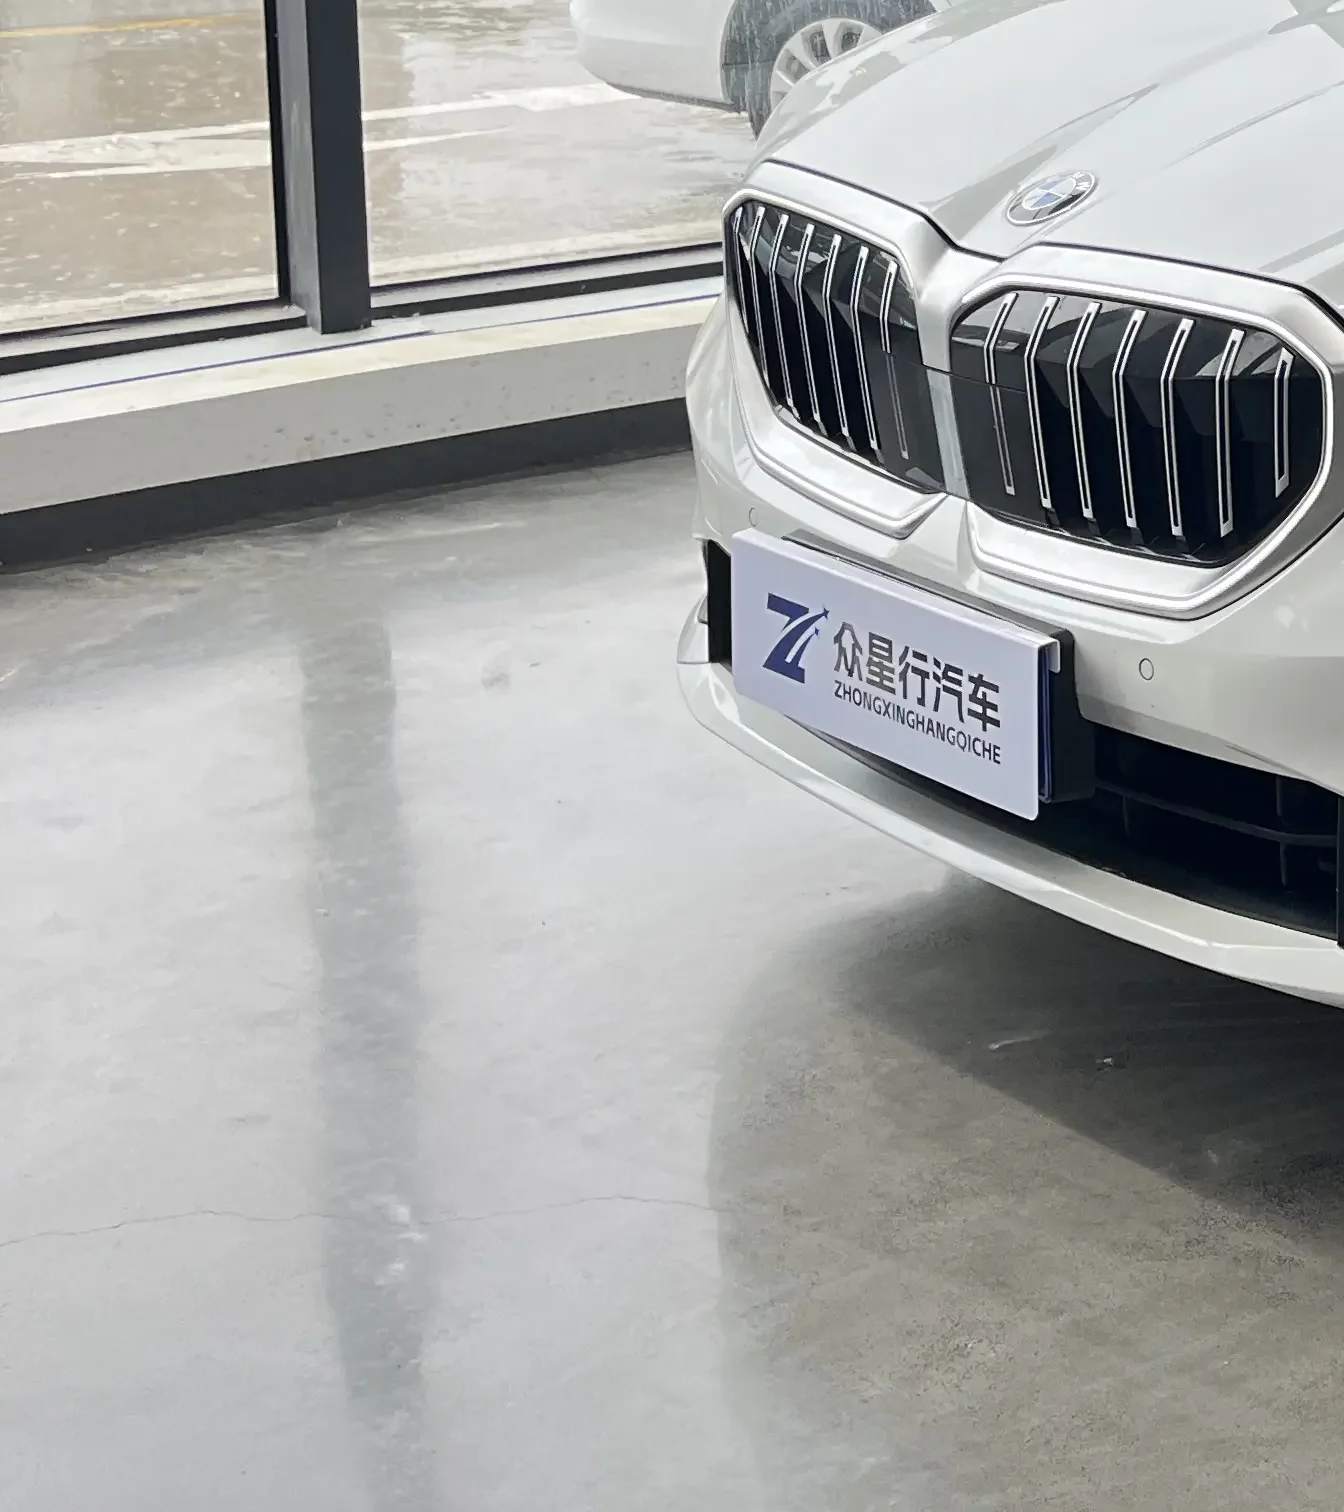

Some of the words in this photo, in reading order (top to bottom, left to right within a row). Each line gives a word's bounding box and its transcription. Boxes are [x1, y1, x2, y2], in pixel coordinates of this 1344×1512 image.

[833, 621, 1001, 732] 众星行汽车
[833, 680, 1002, 765] ZHONGXINGHANGQICHE
